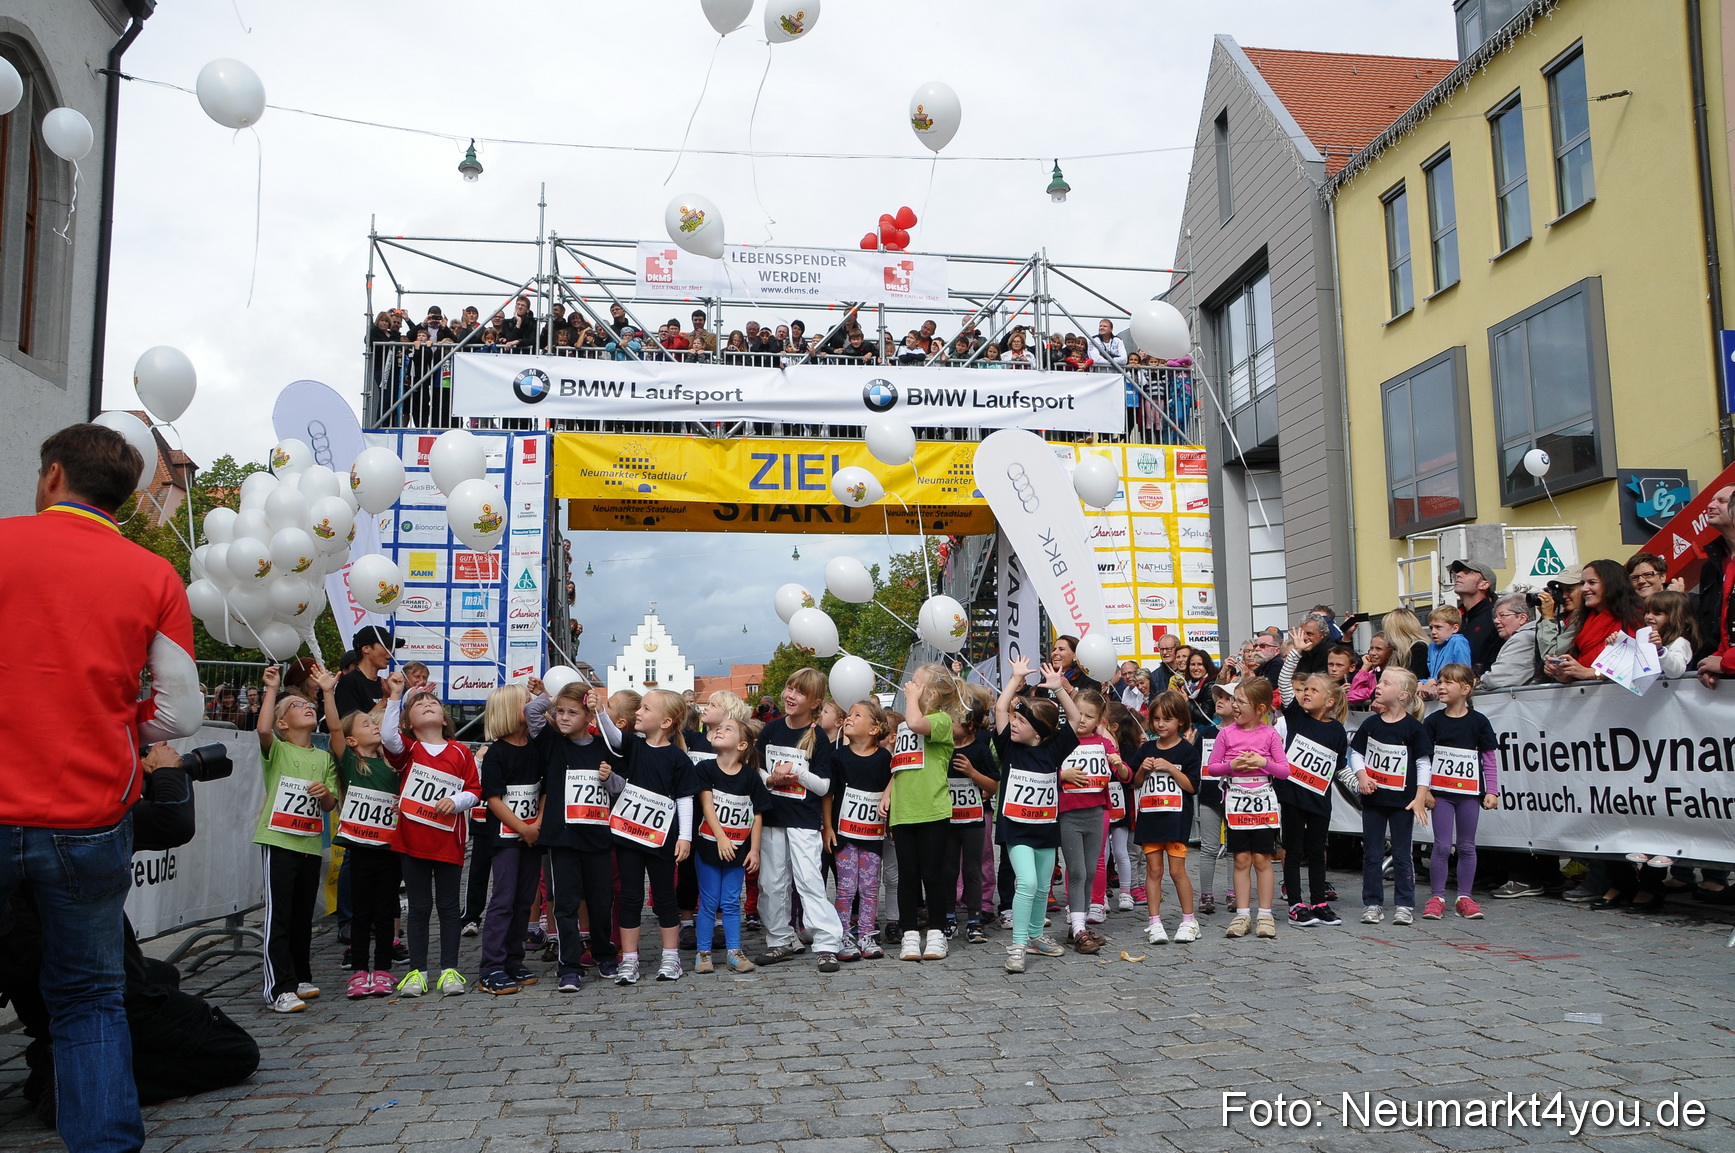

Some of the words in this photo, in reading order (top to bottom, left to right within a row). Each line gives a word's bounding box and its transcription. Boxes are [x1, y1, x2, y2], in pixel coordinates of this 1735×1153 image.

[732, 251, 847, 267] LEBENSSPENDER
[647, 273, 672, 282] DKMS
[758, 270, 821, 283] WERDEN!
[760, 286, 819, 295] www.dkms.de
[885, 283, 909, 292] DKMS
[559, 379, 625, 398] BMW
[630, 381, 744, 405] Laufsport
[906, 387, 967, 407] BMW
[972, 389, 1075, 412] Laufsport
[580, 468, 639, 480] Neumarkter
[641, 471, 688, 481] Stadtlauf
[917, 476, 973, 485] Neumarkter
[592, 504, 644, 513] Neumarkter
[646, 505, 687, 514] Stadtlauf
[886, 509, 934, 518] Neumarkter
[935, 509, 972, 518] Stadtlauf
[415, 523, 444, 531] Bionorica
[1097, 563, 1115, 571] wn
[464, 596, 484, 606] max
[510, 622, 530, 630] swn
[452, 675, 495, 690] Charivari
[895, 733, 919, 754] 203
[1377, 747, 1400, 756] Neumarkt
[1292, 746, 1331, 777] 7050
[1367, 749, 1402, 773] 7047
[1494, 727, 1735, 783] ficientDyna
[1067, 757, 1107, 775] 7208
[1437, 758, 1474, 778] 7348
[412, 768, 430, 779] PARTL
[431, 774, 457, 788] Neumarkt
[1010, 773, 1028, 783] PARTL
[1292, 769, 1308, 781] Jule
[280, 781, 301, 790] PARTL
[410, 777, 456, 802] 704
[348, 790, 364, 799] PARTL
[623, 788, 638, 798] PARTL
[638, 793, 667, 808] Neumarkt
[845, 791, 862, 800] PARTL
[950, 789, 977, 806] 053
[1013, 784, 1055, 806] 7279
[1497, 785, 1582, 814] brauch.
[1590, 785, 1656, 816] Mehr
[1664, 787, 1735, 820] Fahr
[509, 800, 539, 819] 733
[847, 800, 882, 822] 705
[1232, 796, 1272, 813] 7281
[348, 800, 394, 826] 7048
[416, 806, 438, 820] Anna
[585, 808, 600, 818] Jule
[620, 797, 666, 829] 7176
[713, 803, 749, 826] 7054
[353, 826, 379, 838] Vivien
[621, 822, 650, 839] Sophie
[131, 848, 178, 888] eude.
